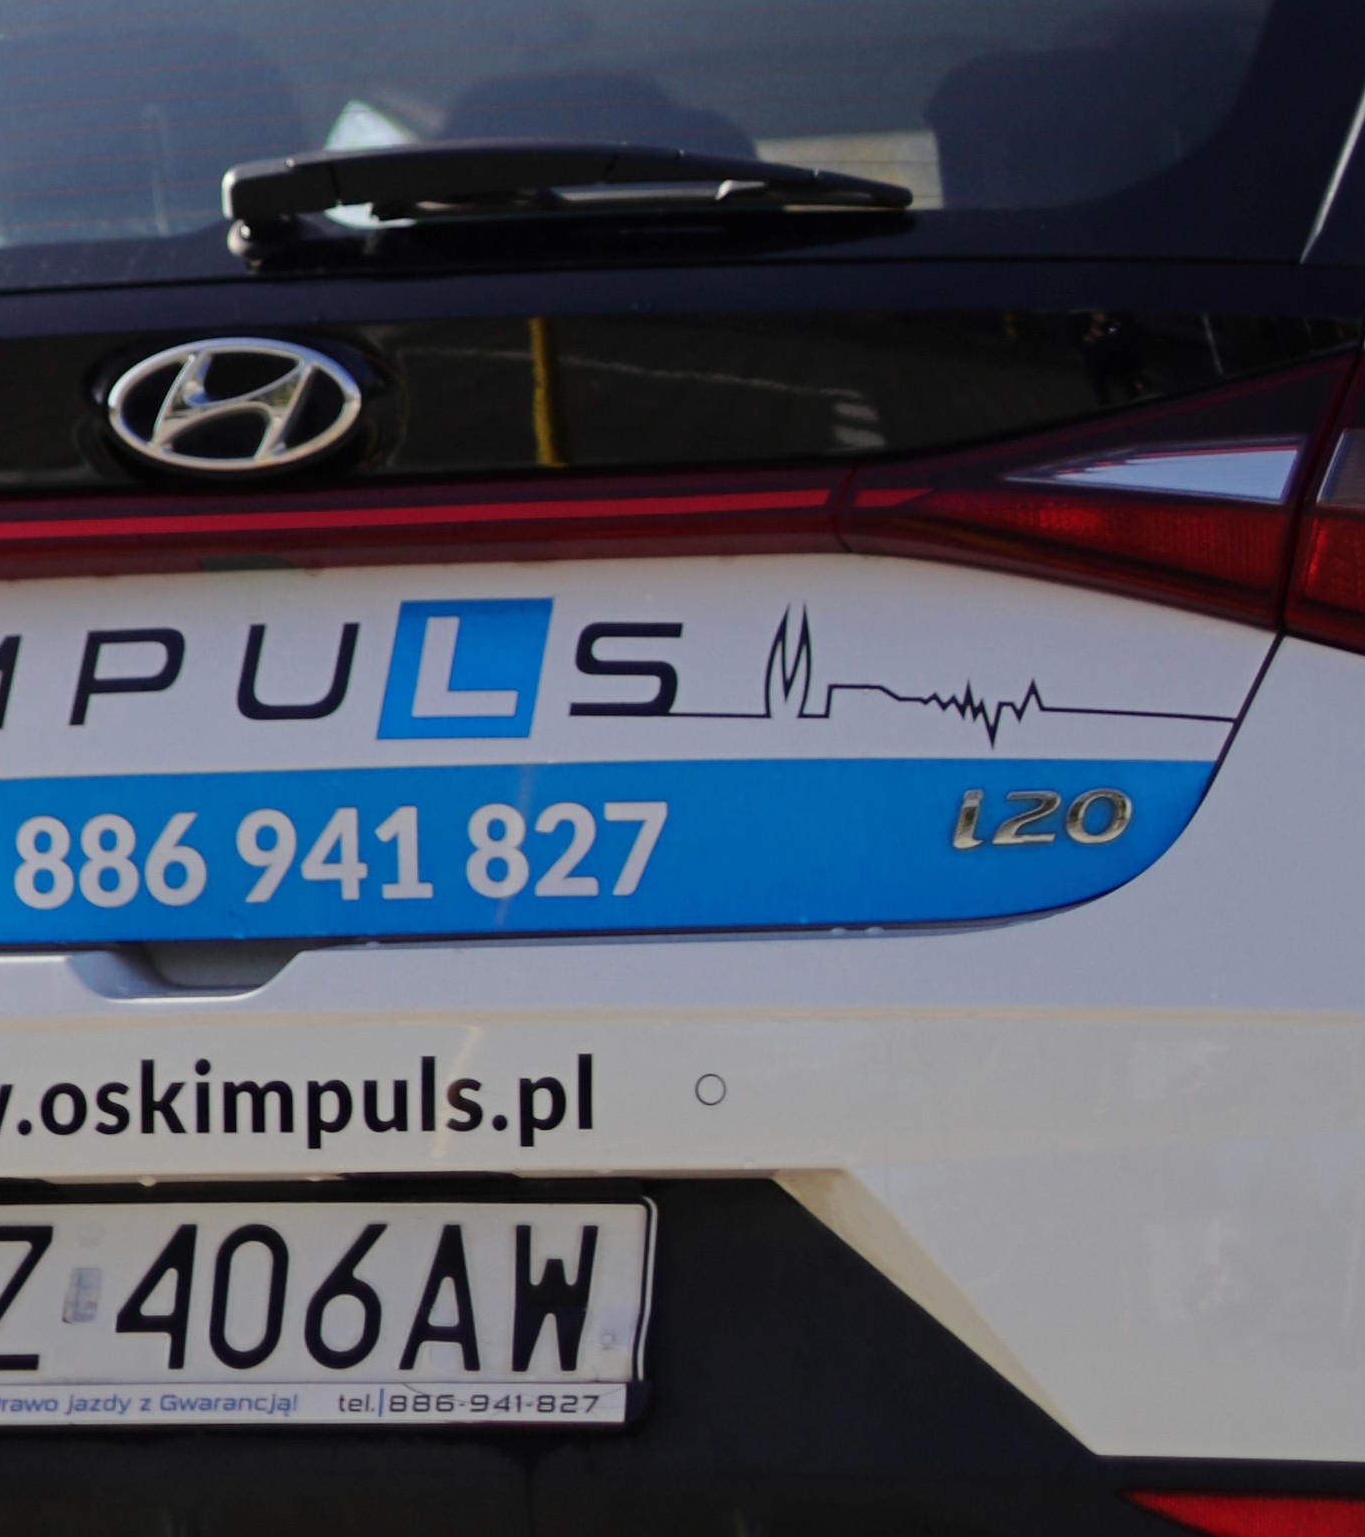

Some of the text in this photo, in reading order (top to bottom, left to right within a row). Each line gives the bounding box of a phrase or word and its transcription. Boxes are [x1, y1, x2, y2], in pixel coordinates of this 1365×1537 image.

[13, 811, 208, 911] 886
[236, 805, 432, 904] 941
[465, 801, 669, 899] 827
[948, 788, 1134, 851] i20
[114, 1222, 601, 1373] 406AW
[66, 1393, 132, 1416] jazdy
[139, 1397, 152, 1412] z
[159, 1393, 300, 1417] Gwarancją!
[338, 1393, 376, 1413] tel.
[388, 1393, 601, 1415] 886-941-827
